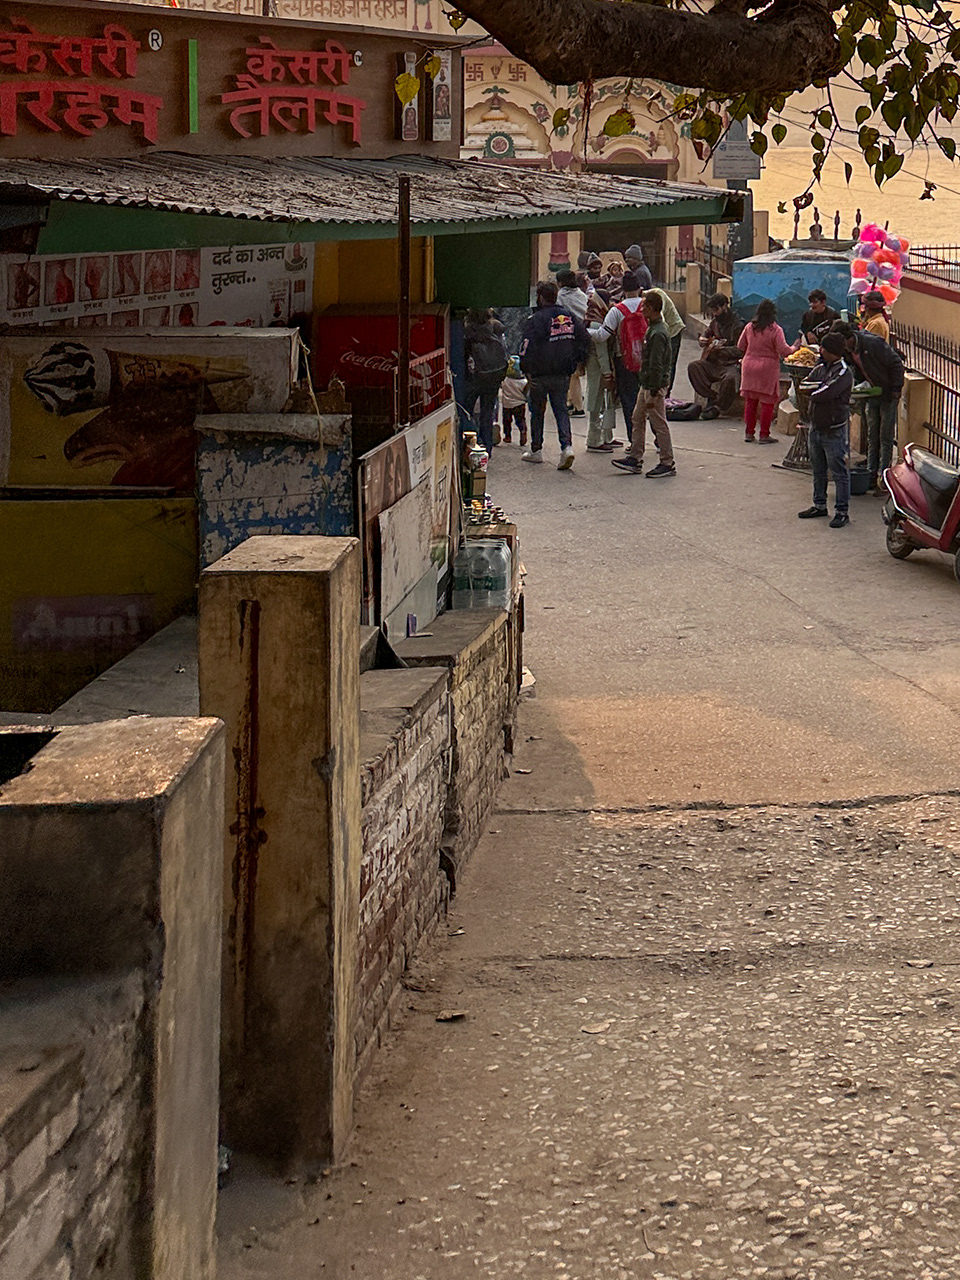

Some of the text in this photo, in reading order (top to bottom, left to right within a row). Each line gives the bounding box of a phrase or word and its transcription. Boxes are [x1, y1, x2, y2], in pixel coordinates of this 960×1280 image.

[0, 16, 141, 78] केसरी
[246, 36, 352, 84] केसरी
[222, 74, 366, 145] तैलम
[212, 246, 286, 265] दर्द का अन्त
